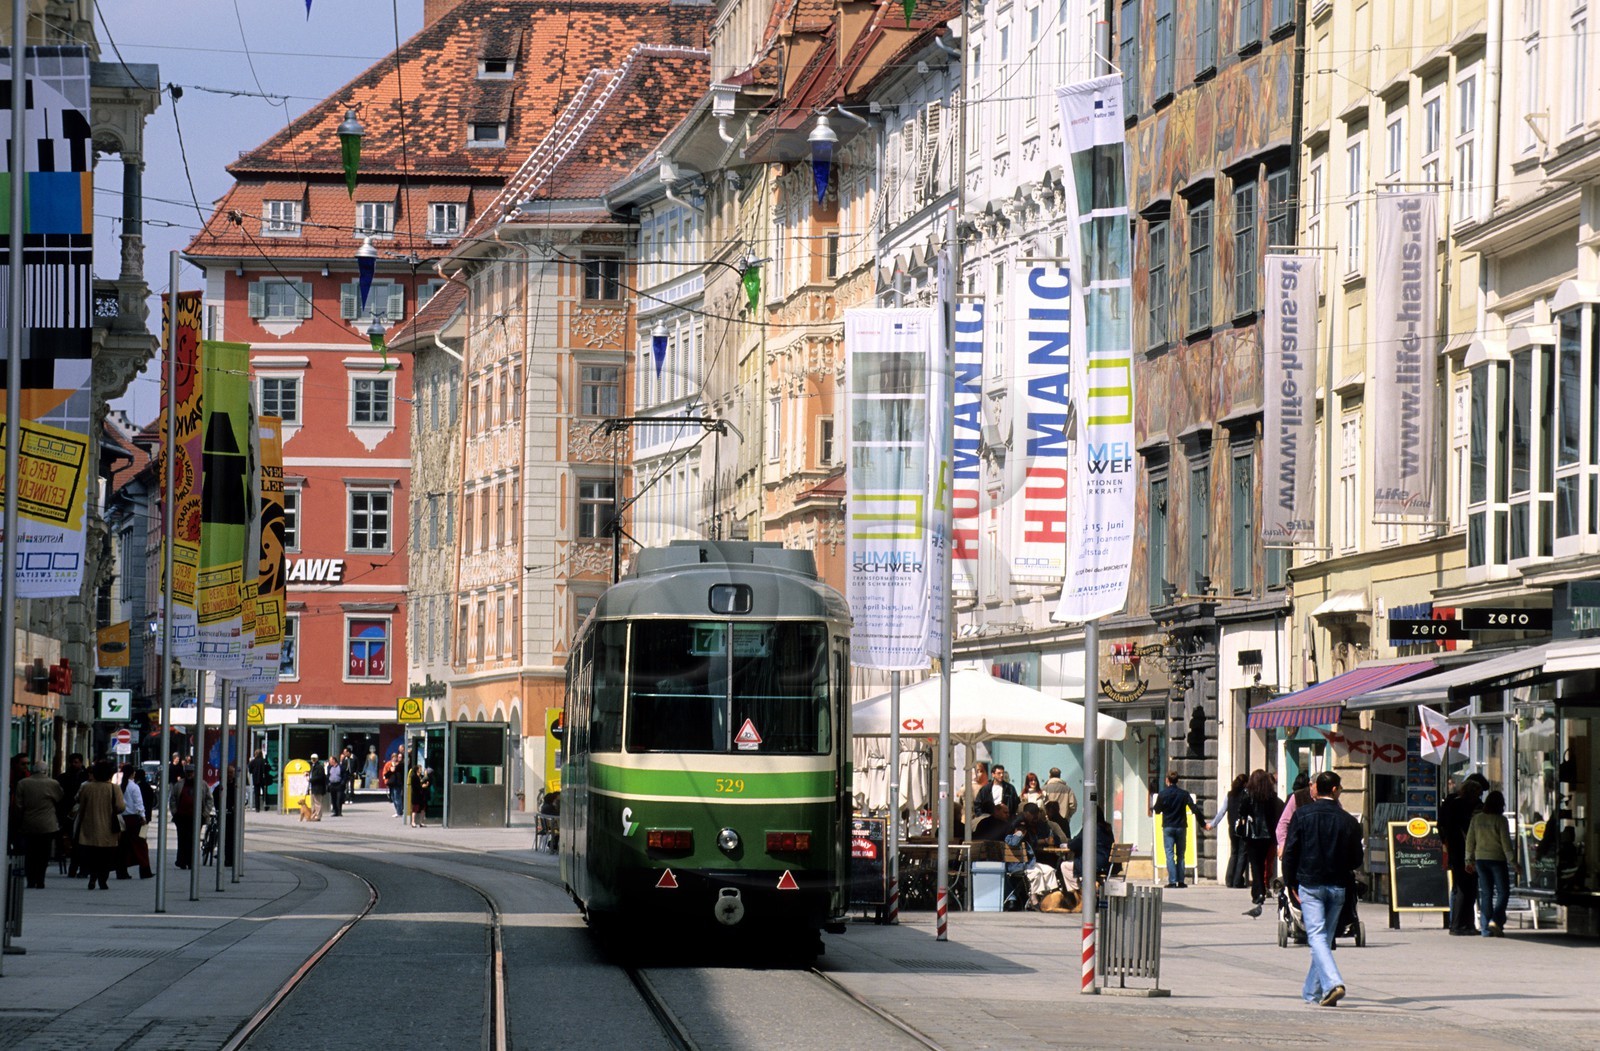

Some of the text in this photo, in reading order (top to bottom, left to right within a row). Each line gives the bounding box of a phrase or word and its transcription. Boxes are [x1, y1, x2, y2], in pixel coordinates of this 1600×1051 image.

[1396, 198, 1422, 480] www.life-haus.at
[1025, 267, 1071, 543] HUMANIC
[952, 303, 984, 560] HUMANIC
[1107, 519, 1124, 532] Juni
[852, 551, 922, 563] HIMMEL
[852, 562, 922, 573] SCHWER
[226, 584, 237, 596] DER
[725, 587, 737, 611] 7
[257, 615, 269, 626] DER
[1488, 613, 1529, 625] zero
[1411, 625, 1447, 635] zero
[715, 778, 745, 794] 529
